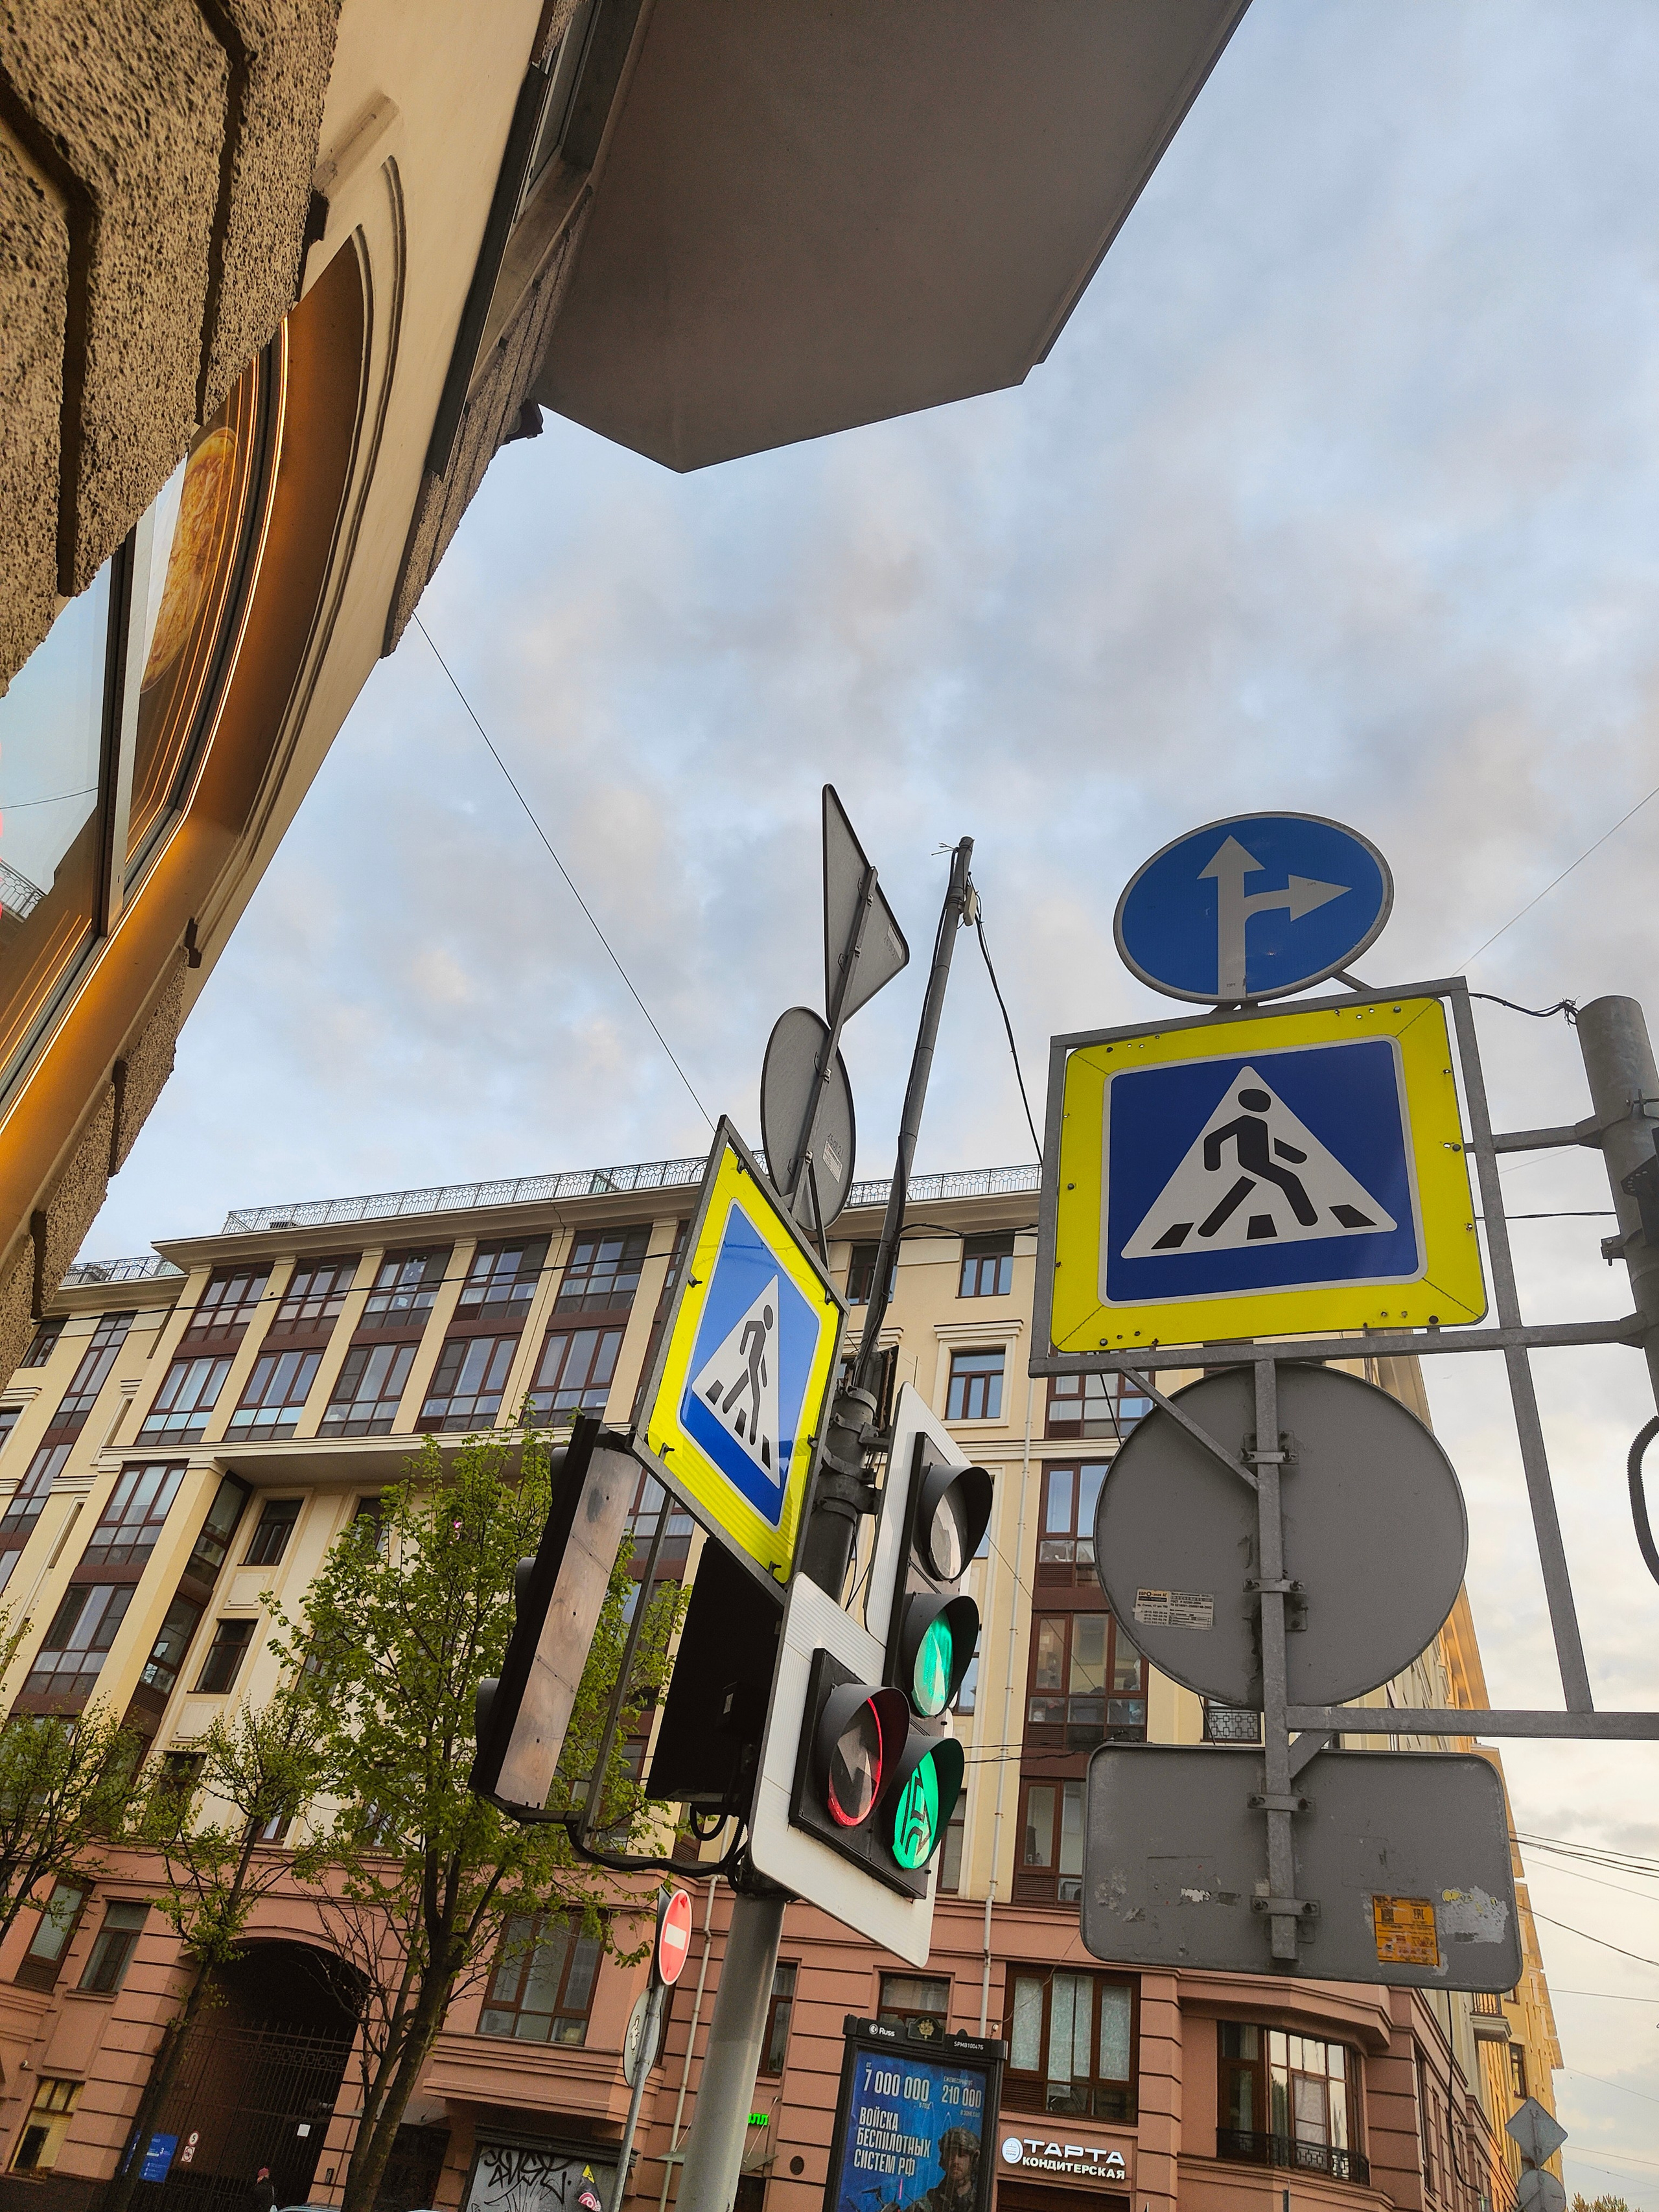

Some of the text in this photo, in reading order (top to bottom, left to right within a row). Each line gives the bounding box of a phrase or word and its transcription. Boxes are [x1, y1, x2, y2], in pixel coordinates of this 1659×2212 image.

[879, 2027, 896, 2037] Russ
[863, 2069, 930, 2102] 7 000 000
[942, 2085, 982, 2109] 210 000
[859, 2106, 899, 2132] ВОЙСКА
[857, 2127, 932, 2158] БЕСПИЛОТНЫХ
[1023, 2137, 1126, 2167] ТАРТА
[853, 2148, 916, 2177] СИСТЕМ РФ
[1022, 2156, 1126, 2180] КОНДИТЕРСКАЯ
